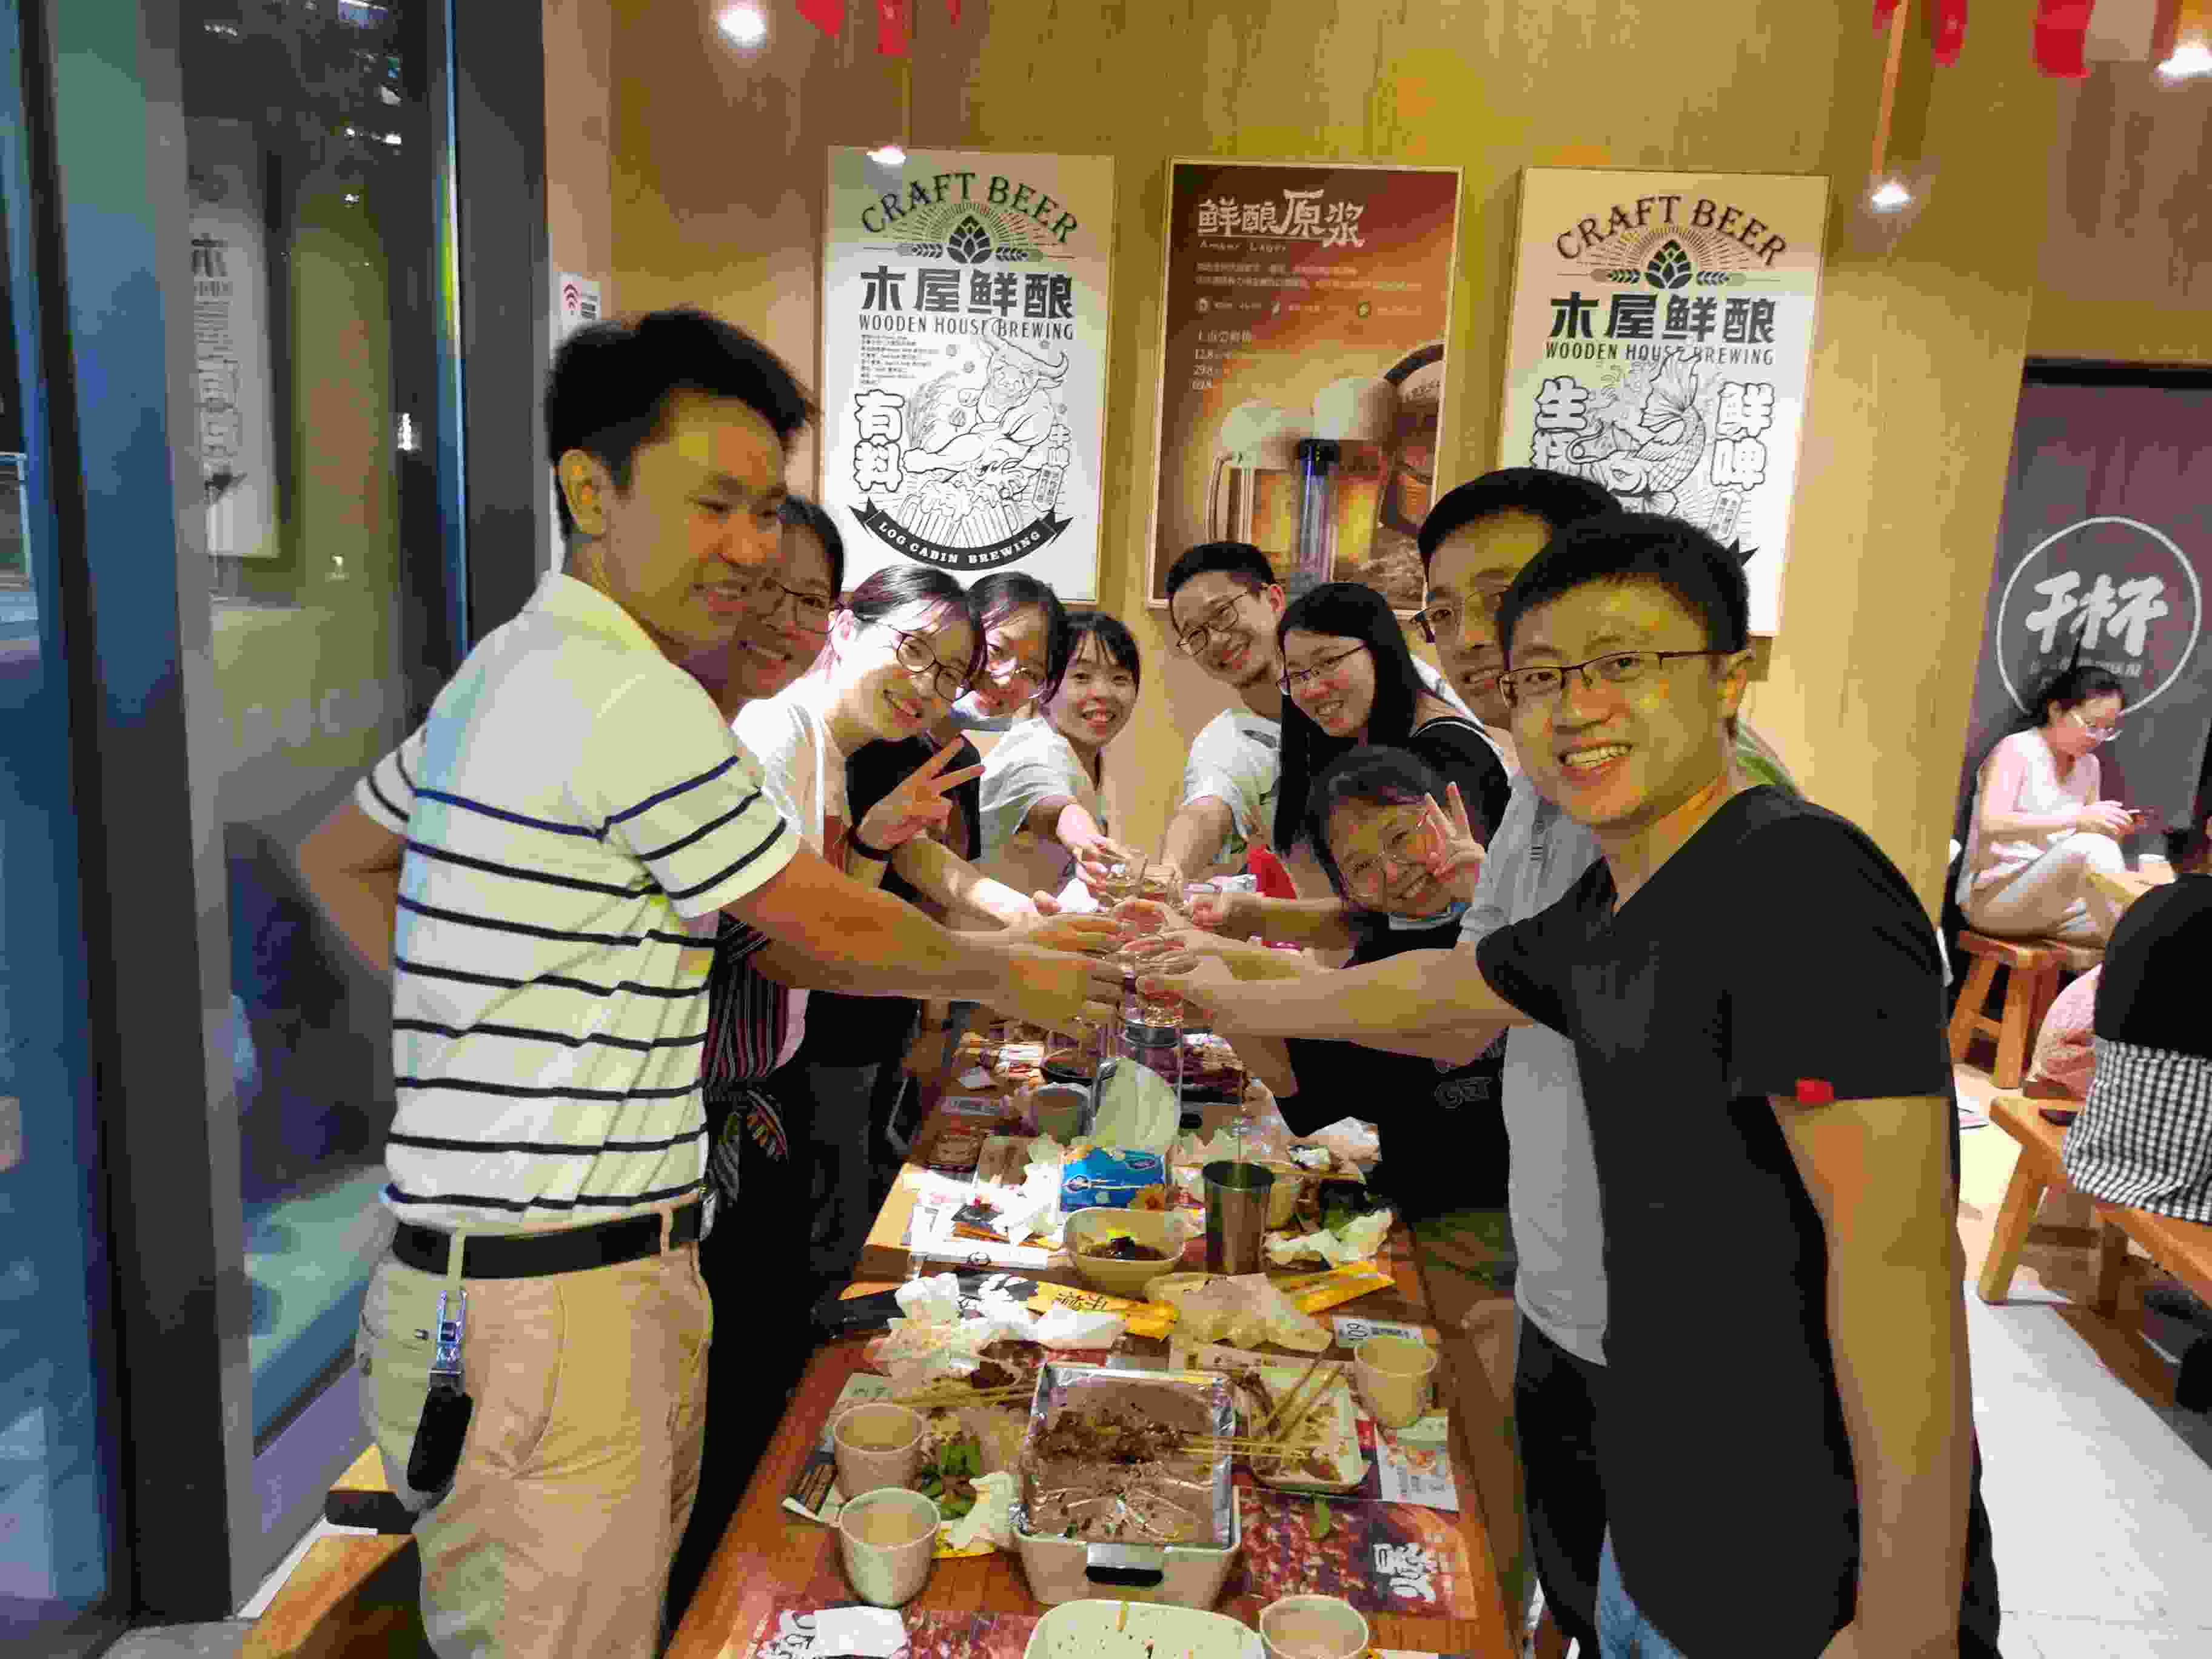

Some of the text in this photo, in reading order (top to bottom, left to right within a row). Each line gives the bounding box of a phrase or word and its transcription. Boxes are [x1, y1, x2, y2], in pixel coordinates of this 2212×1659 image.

[860, 172, 1078, 243] CRAFT BEER
[1198, 189, 1366, 248] 鲜酿原浆
[1556, 195, 1786, 266] CRAFT BEER
[859, 265, 1074, 319] 木屋鲜酿
[1550, 291, 1777, 344] 木屋鲜酿
[859, 315, 1073, 340] WOODEN HOUSE BREWING
[1544, 340, 1774, 366] WOODEN HOUSE BREWING
[853, 388, 905, 492] 有料
[1711, 382, 1775, 491] 鲜啤
[877, 520, 1043, 565] LOG CABIN BREWING
